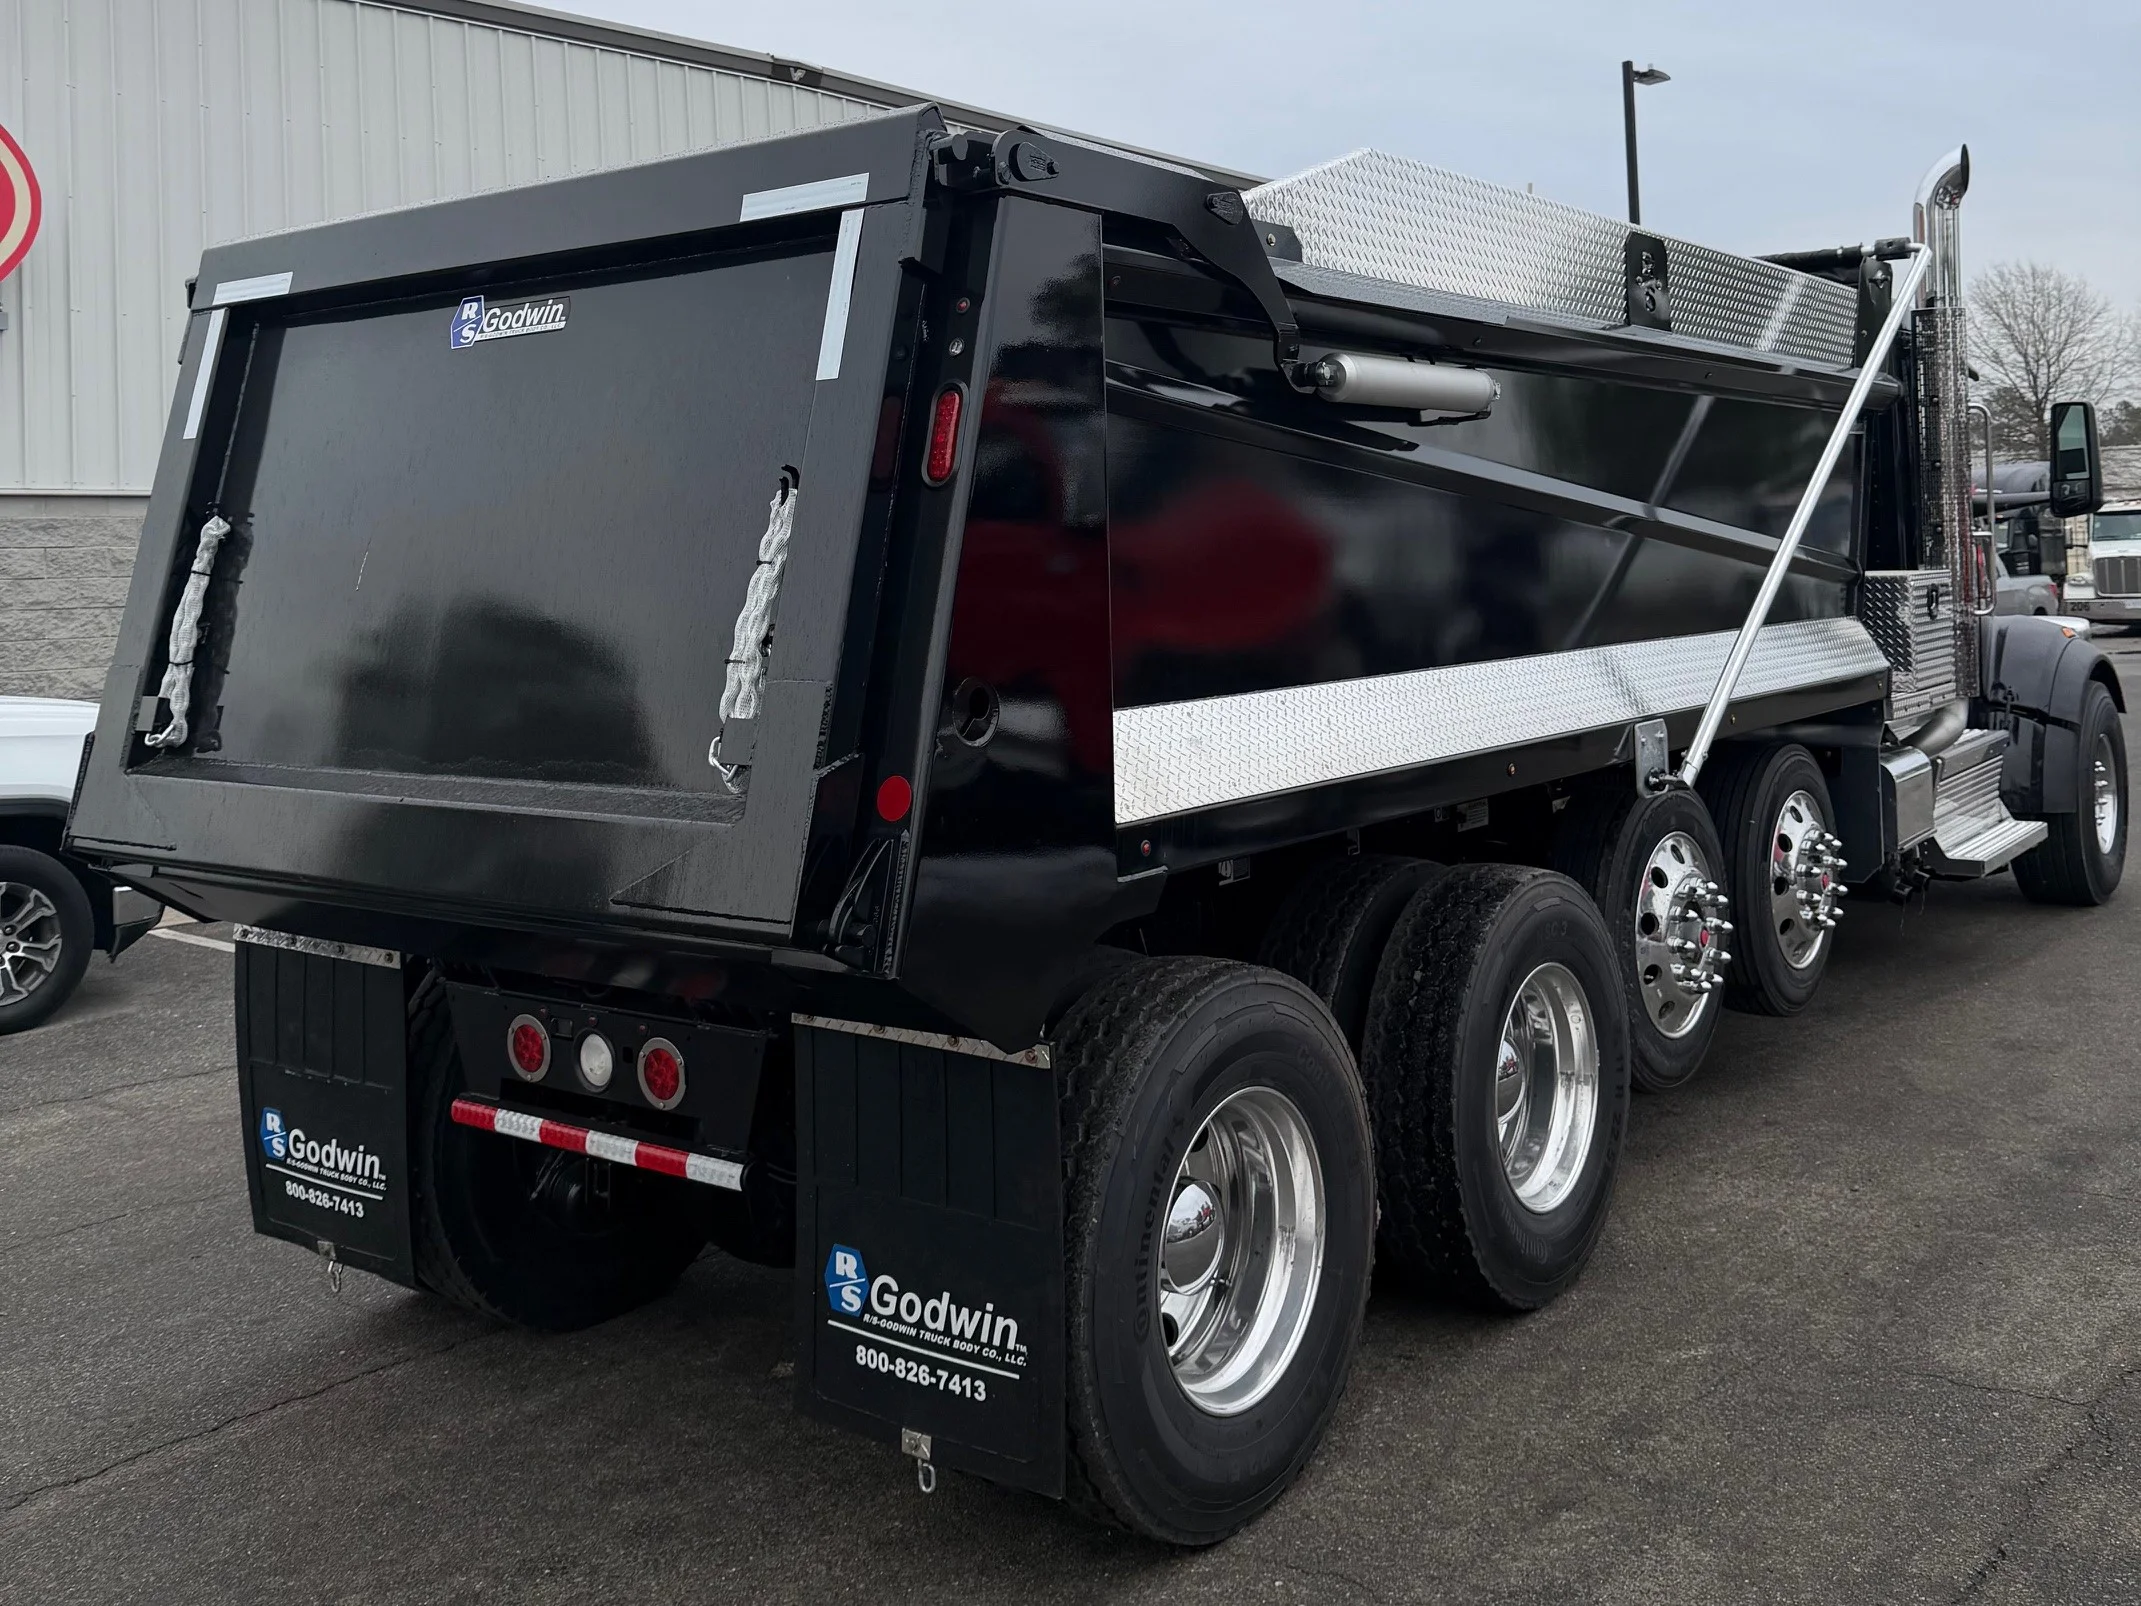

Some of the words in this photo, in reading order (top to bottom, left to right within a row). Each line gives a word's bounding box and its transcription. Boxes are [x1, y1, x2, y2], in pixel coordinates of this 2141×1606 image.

[483, 299, 564, 332] Godwin
[289, 1128, 380, 1179] Godwin
[319, 1168, 340, 1179] TRUCK
[340, 1173, 358, 1184] BODY
[285, 1180, 365, 1218] 800-826-7413
[870, 1274, 1018, 1350] Godwin
[863, 1313, 917, 1337] R/S-GODWIN
[919, 1329, 951, 1347] TRUCK
[952, 1339, 981, 1355] BODY
[982, 1347, 1002, 1362] CO.,
[856, 1344, 987, 1401] 800-826-7413
